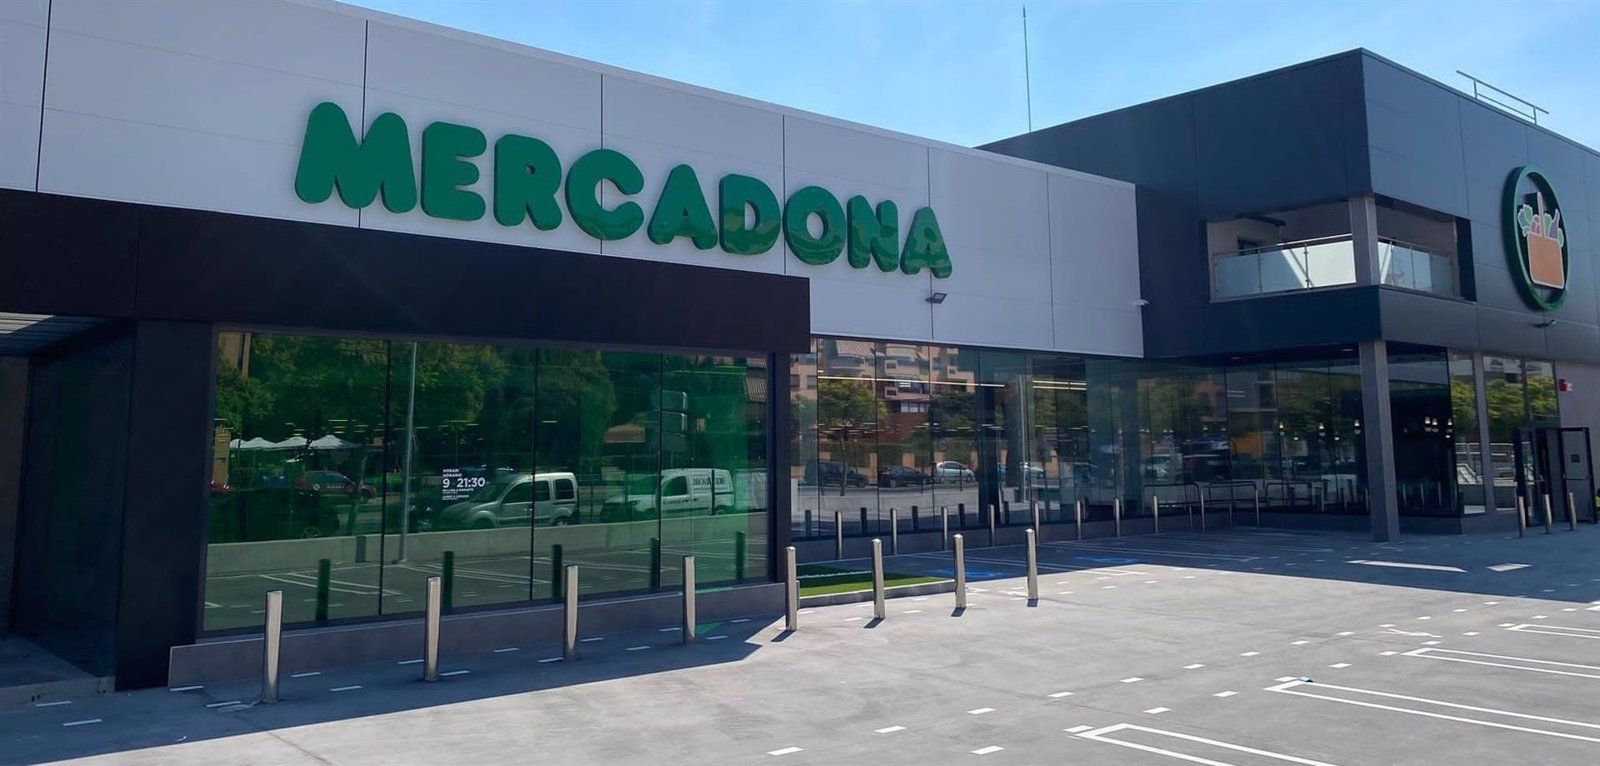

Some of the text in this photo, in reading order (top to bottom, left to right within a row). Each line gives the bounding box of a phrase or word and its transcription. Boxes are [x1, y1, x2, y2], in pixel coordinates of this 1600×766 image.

[295, 102, 952, 278] MERCADONA
[442, 477, 486, 488] 9 21:30
